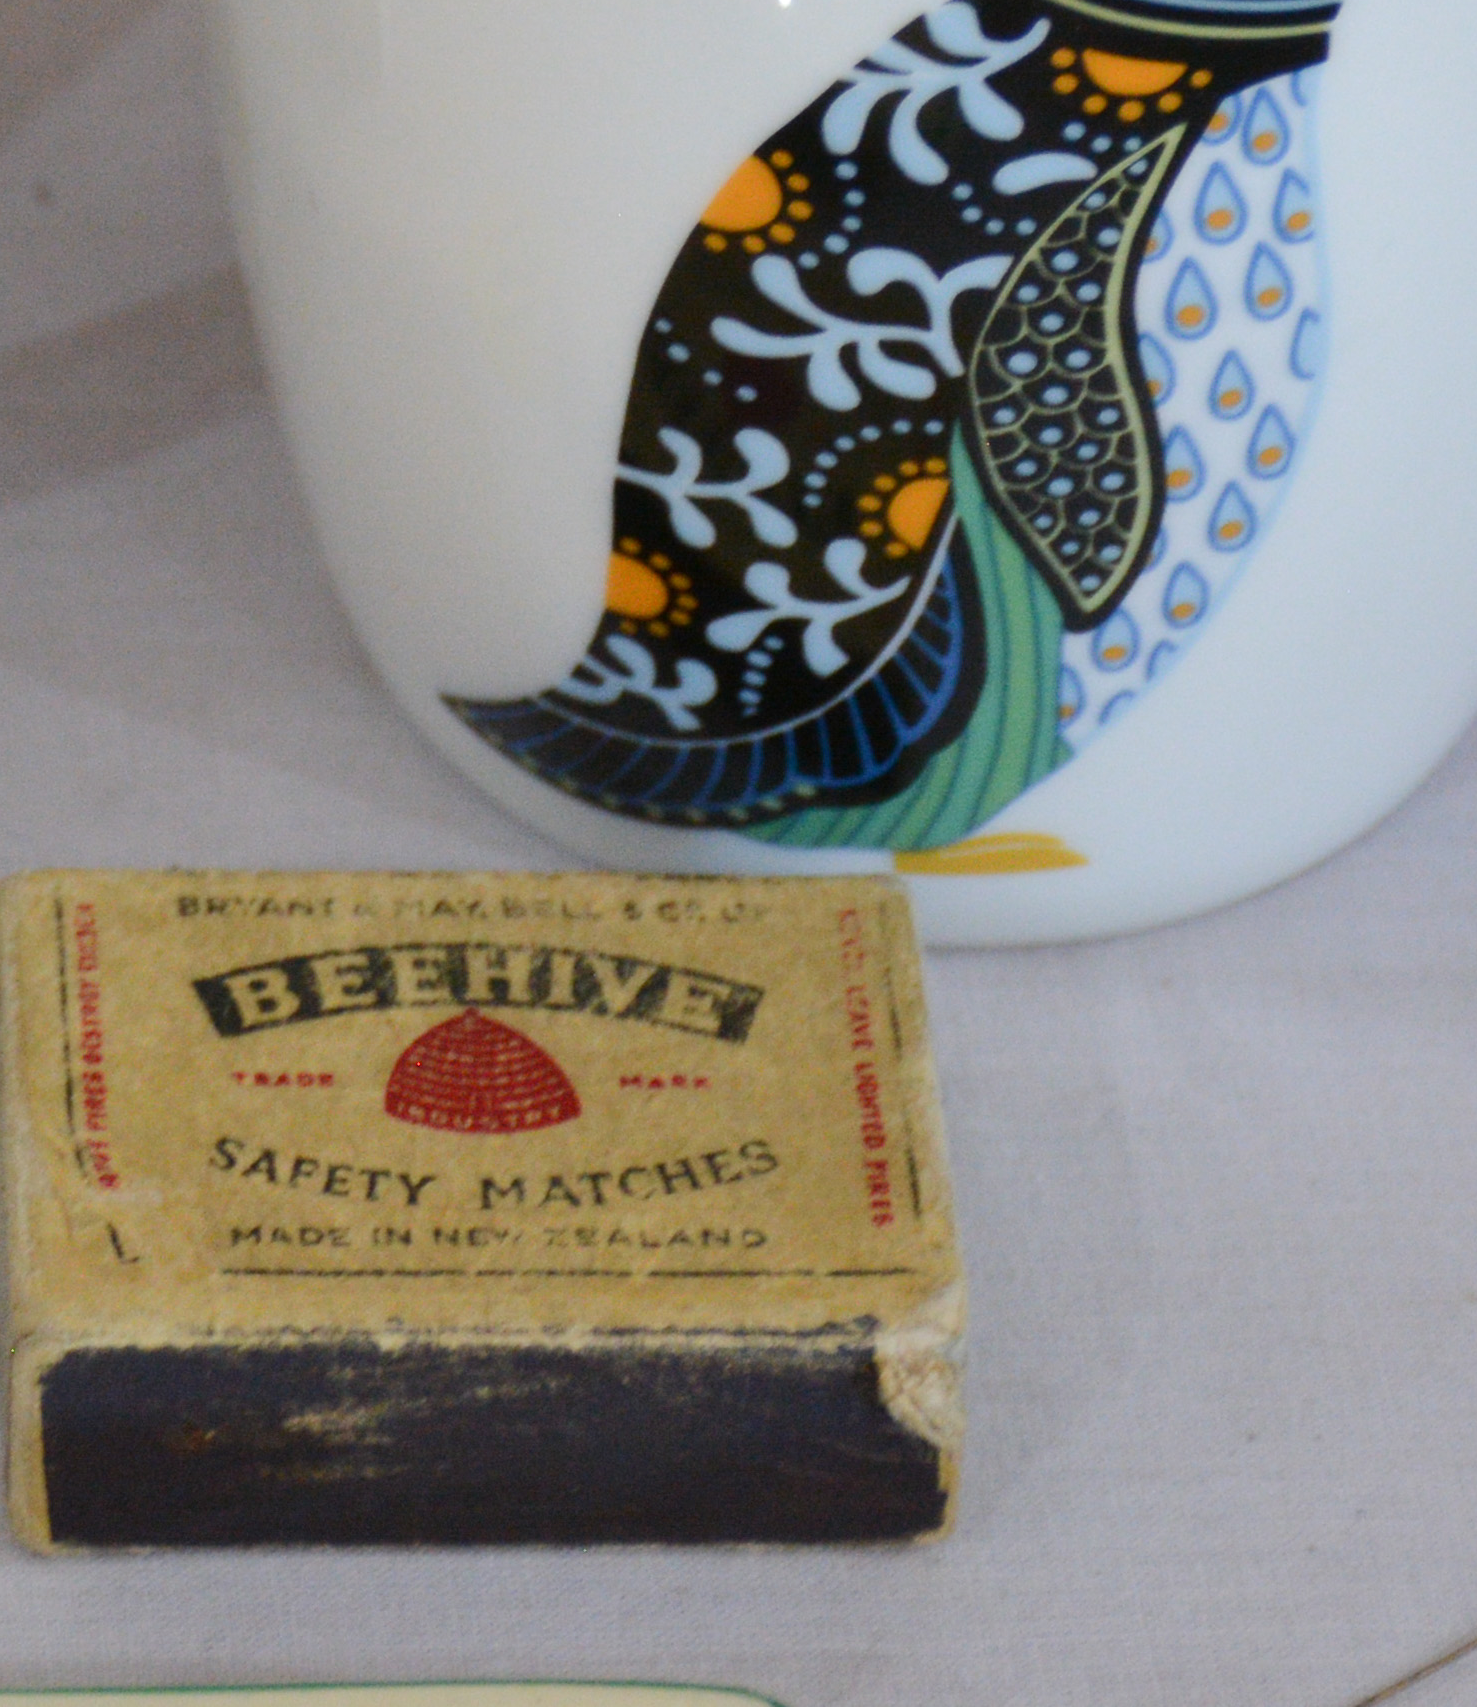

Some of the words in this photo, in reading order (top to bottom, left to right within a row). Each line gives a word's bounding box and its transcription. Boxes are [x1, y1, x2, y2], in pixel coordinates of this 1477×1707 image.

[225, 951, 729, 1032] BEEHIVE
[231, 1070, 335, 1088] TRADE
[619, 1072, 712, 1090] MARK
[208, 1137, 437, 1206] SAFETY
[479, 1139, 779, 1210] MATCHES
[230, 1224, 350, 1247] MADE
[372, 1226, 412, 1246] IN
[542, 1225, 768, 1249] ZEALAND
